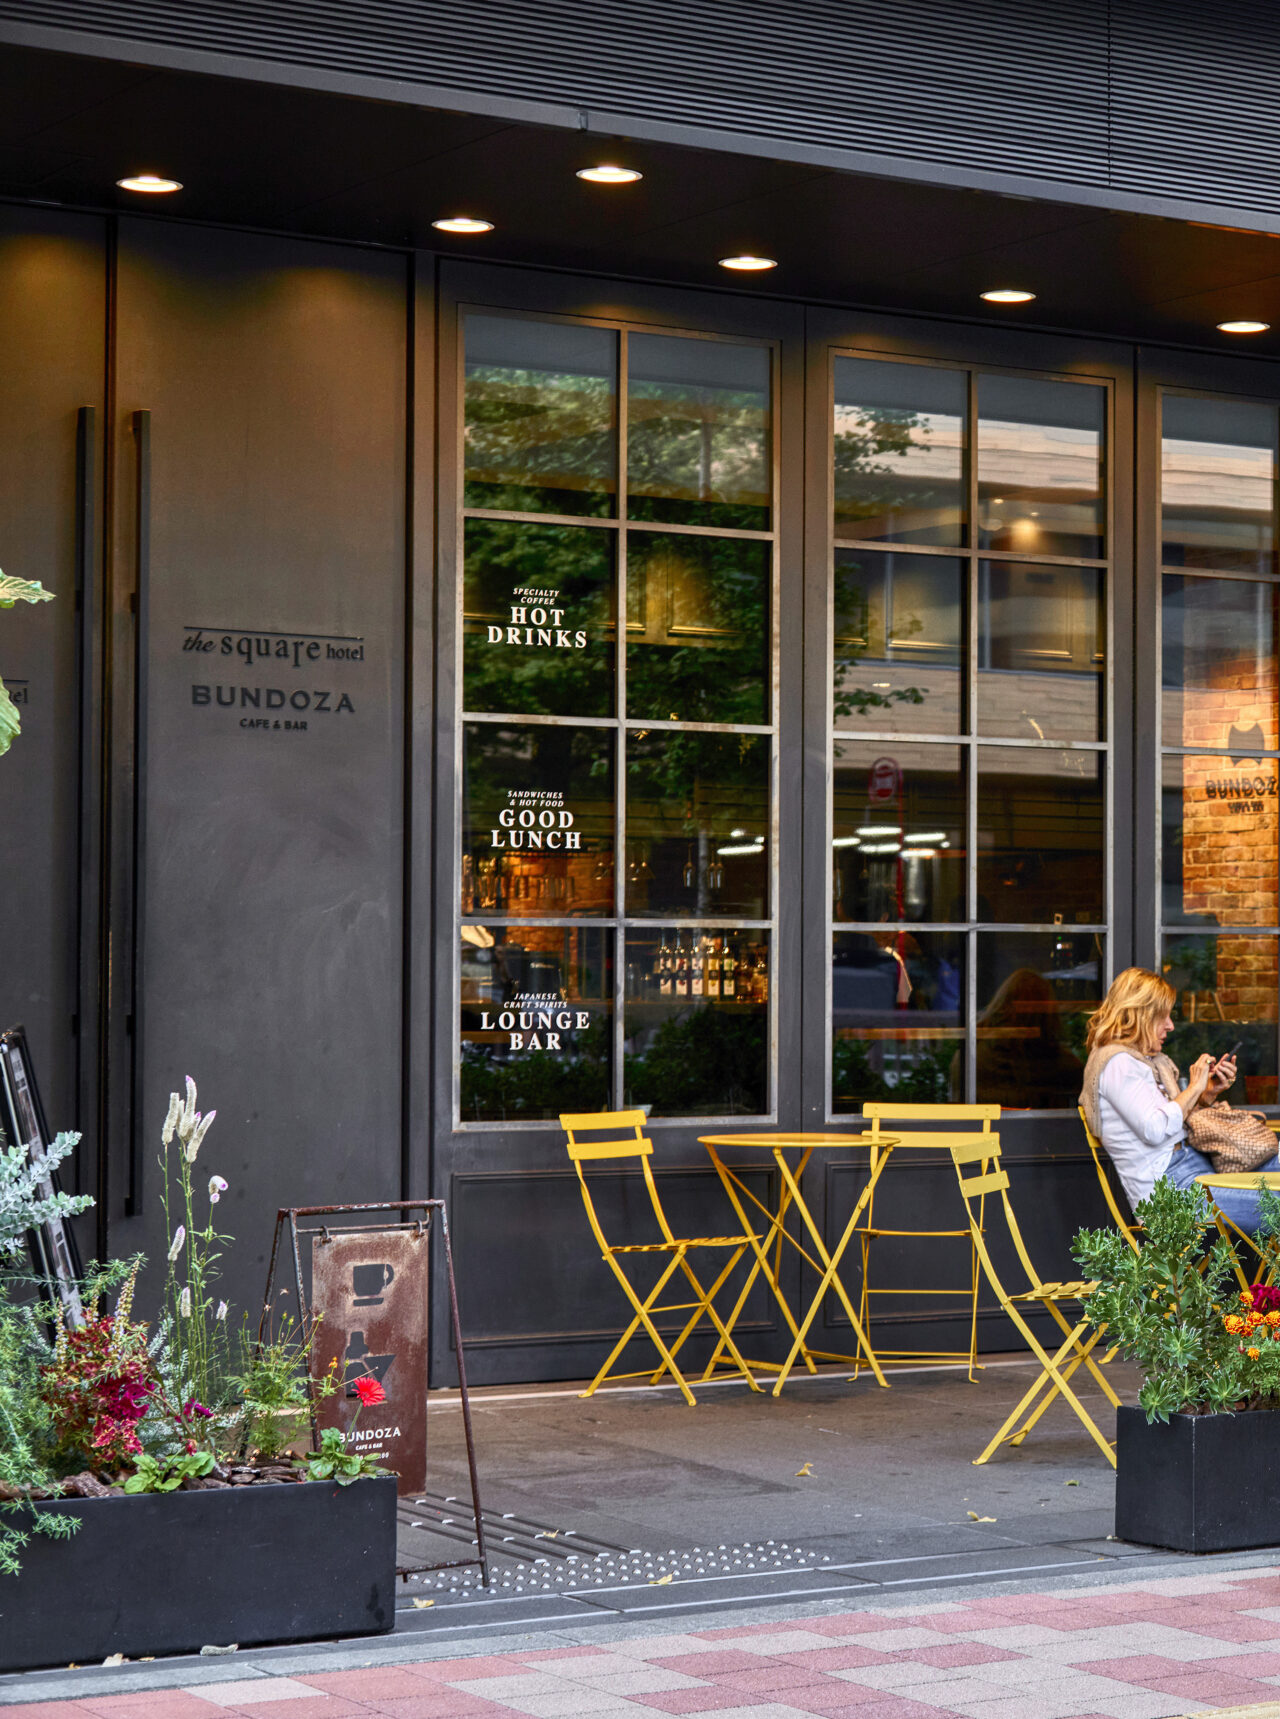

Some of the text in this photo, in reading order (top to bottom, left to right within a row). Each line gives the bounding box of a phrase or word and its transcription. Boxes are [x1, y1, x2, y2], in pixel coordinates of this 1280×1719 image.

[513, 587, 560, 598] SPECIALTY
[520, 596, 555, 605] COFFEE
[510, 606, 565, 626] HOT
[487, 625, 587, 649] DRINKS
[182, 631, 365, 667] the square hotel
[191, 684, 356, 713] BUNDOZA
[239, 718, 308, 731] CAFE & BAR
[507, 790, 563, 799] SANDWICHES
[540, 800, 564, 808] FOOD
[499, 809, 574, 828] GOOD
[491, 830, 582, 849] LUNCH
[503, 1001, 568, 1009] CRAFT SPIRITS
[513, 992, 558, 1000] JAPANESE
[480, 1011, 591, 1030] LOUNGE
[509, 1032, 562, 1051] BAR
[339, 1426, 402, 1443] BUNDOZA
